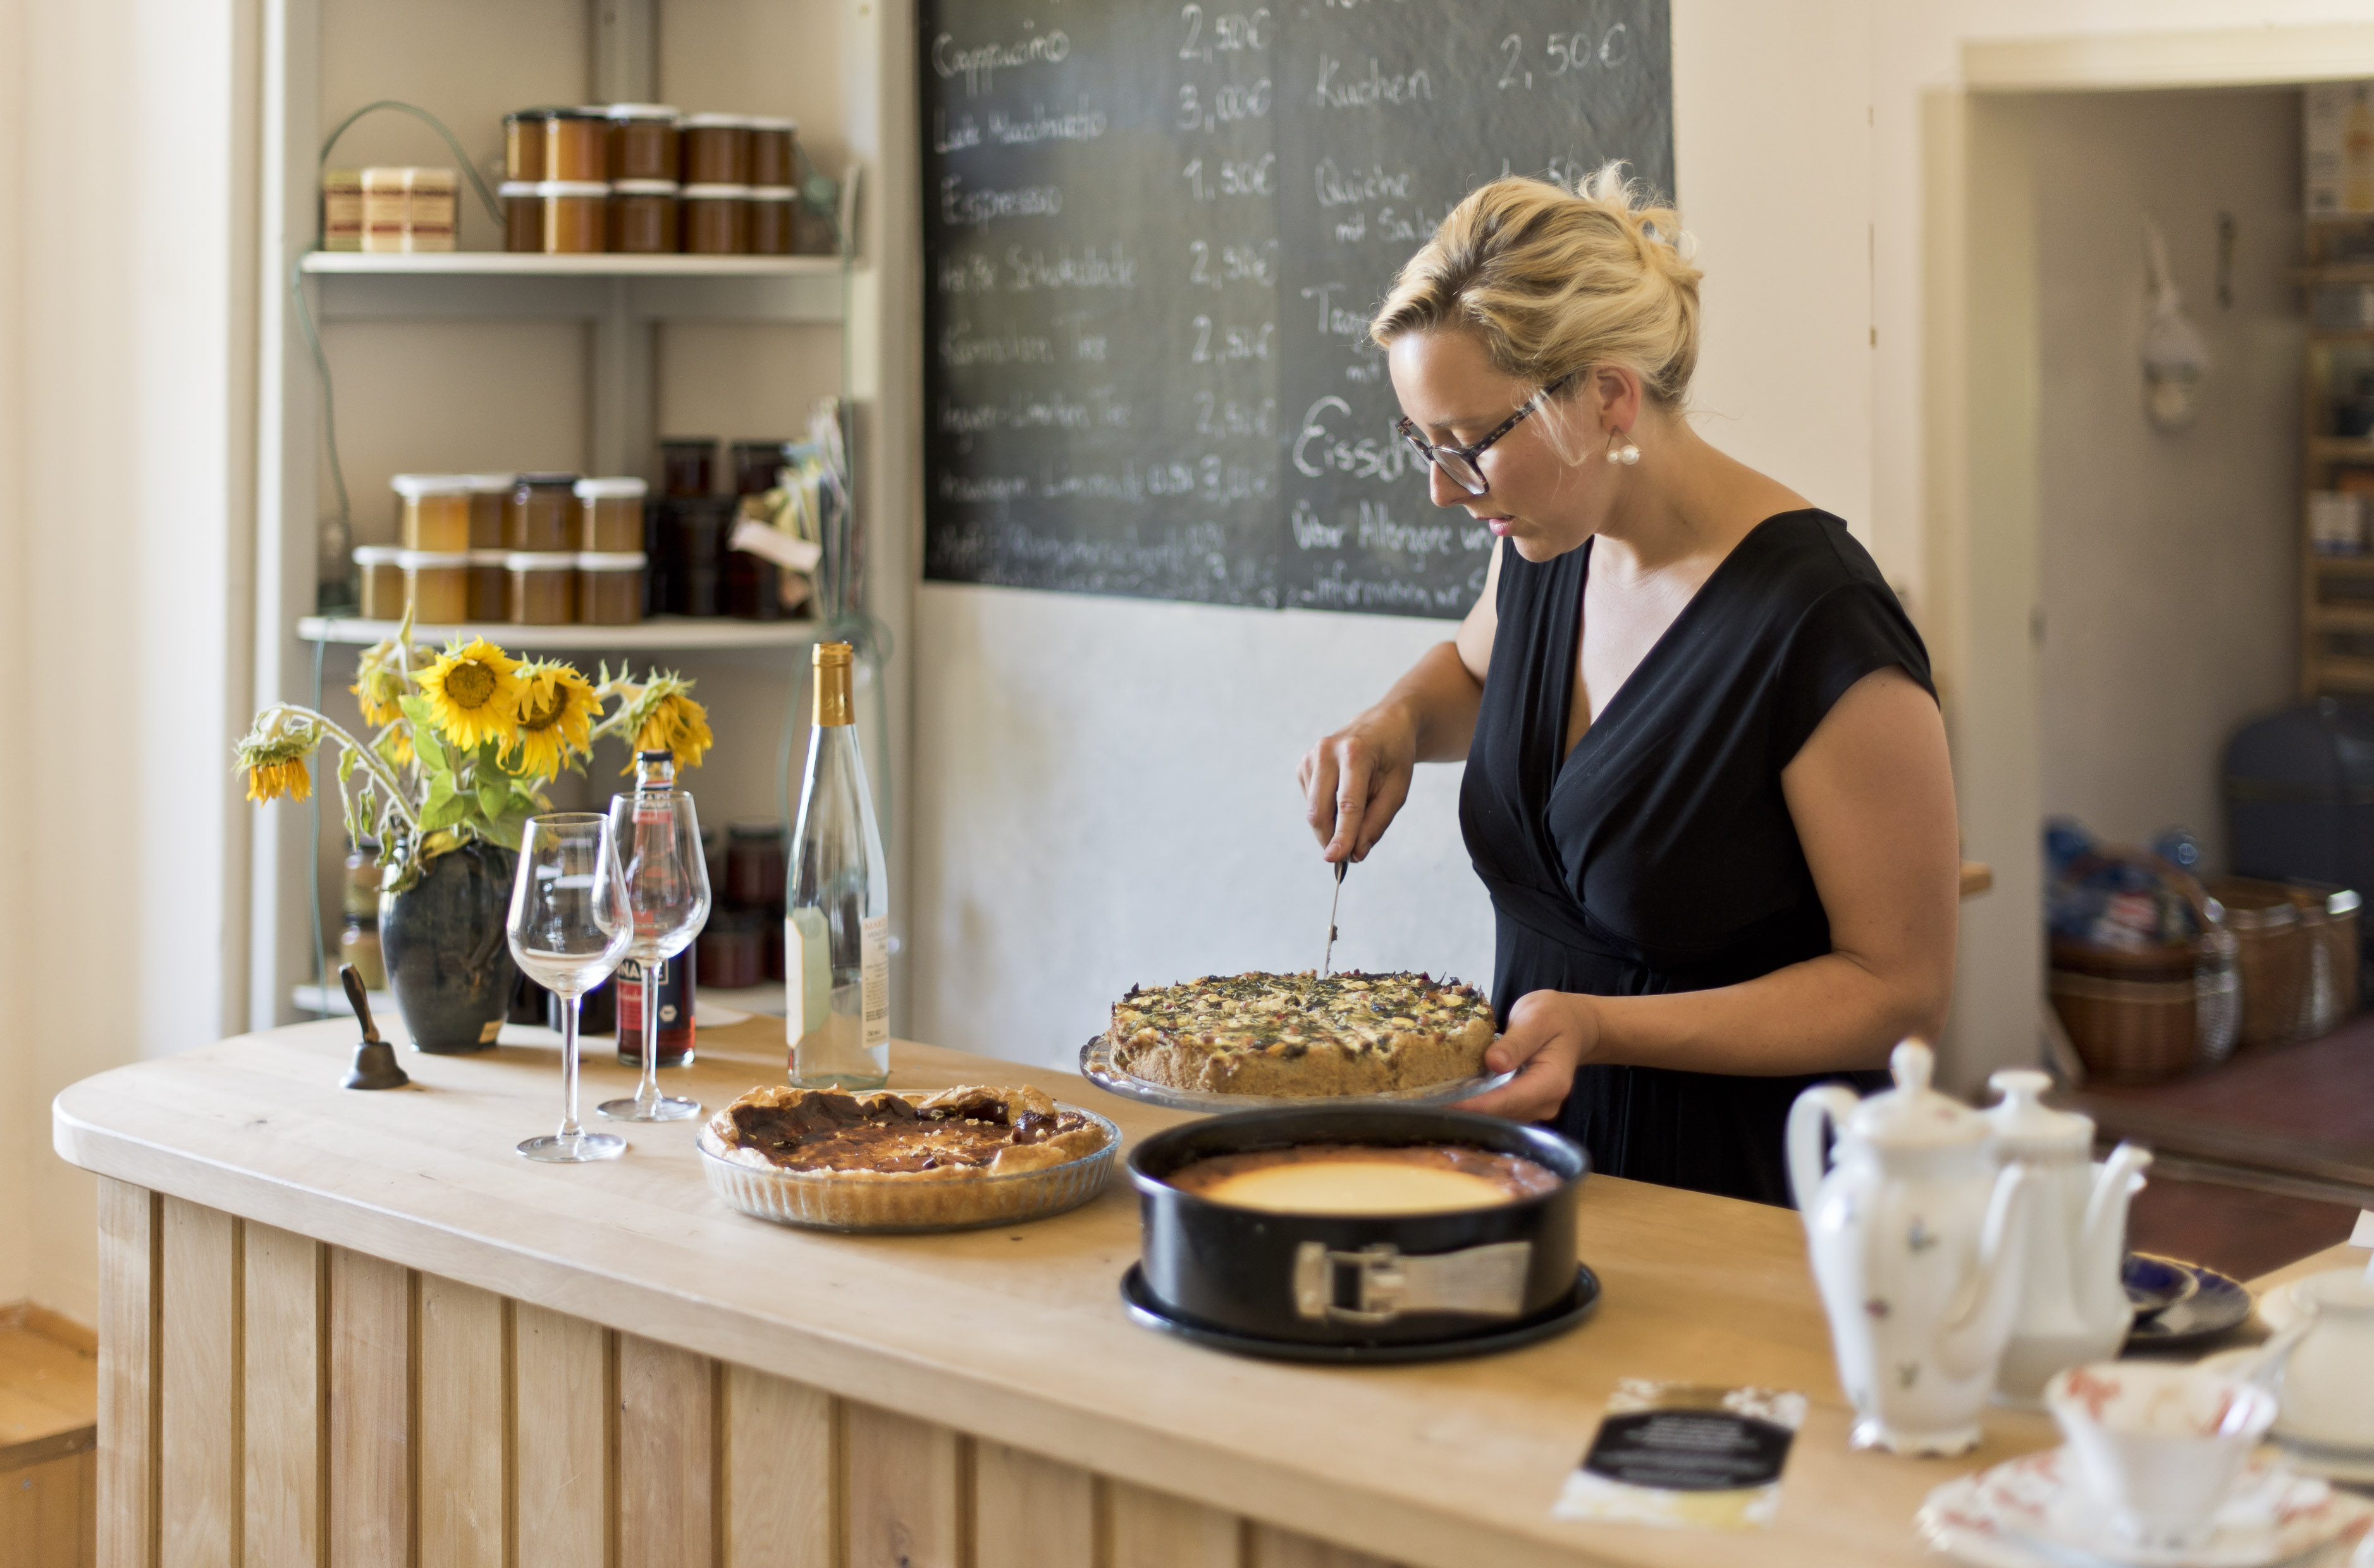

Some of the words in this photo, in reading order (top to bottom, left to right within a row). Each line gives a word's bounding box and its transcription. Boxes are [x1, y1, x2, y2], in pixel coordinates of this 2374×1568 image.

[1315, 52, 1432, 111] Kuchen
[940, 172, 1063, 235] Espresso
[1315, 157, 1410, 207] Quiche
